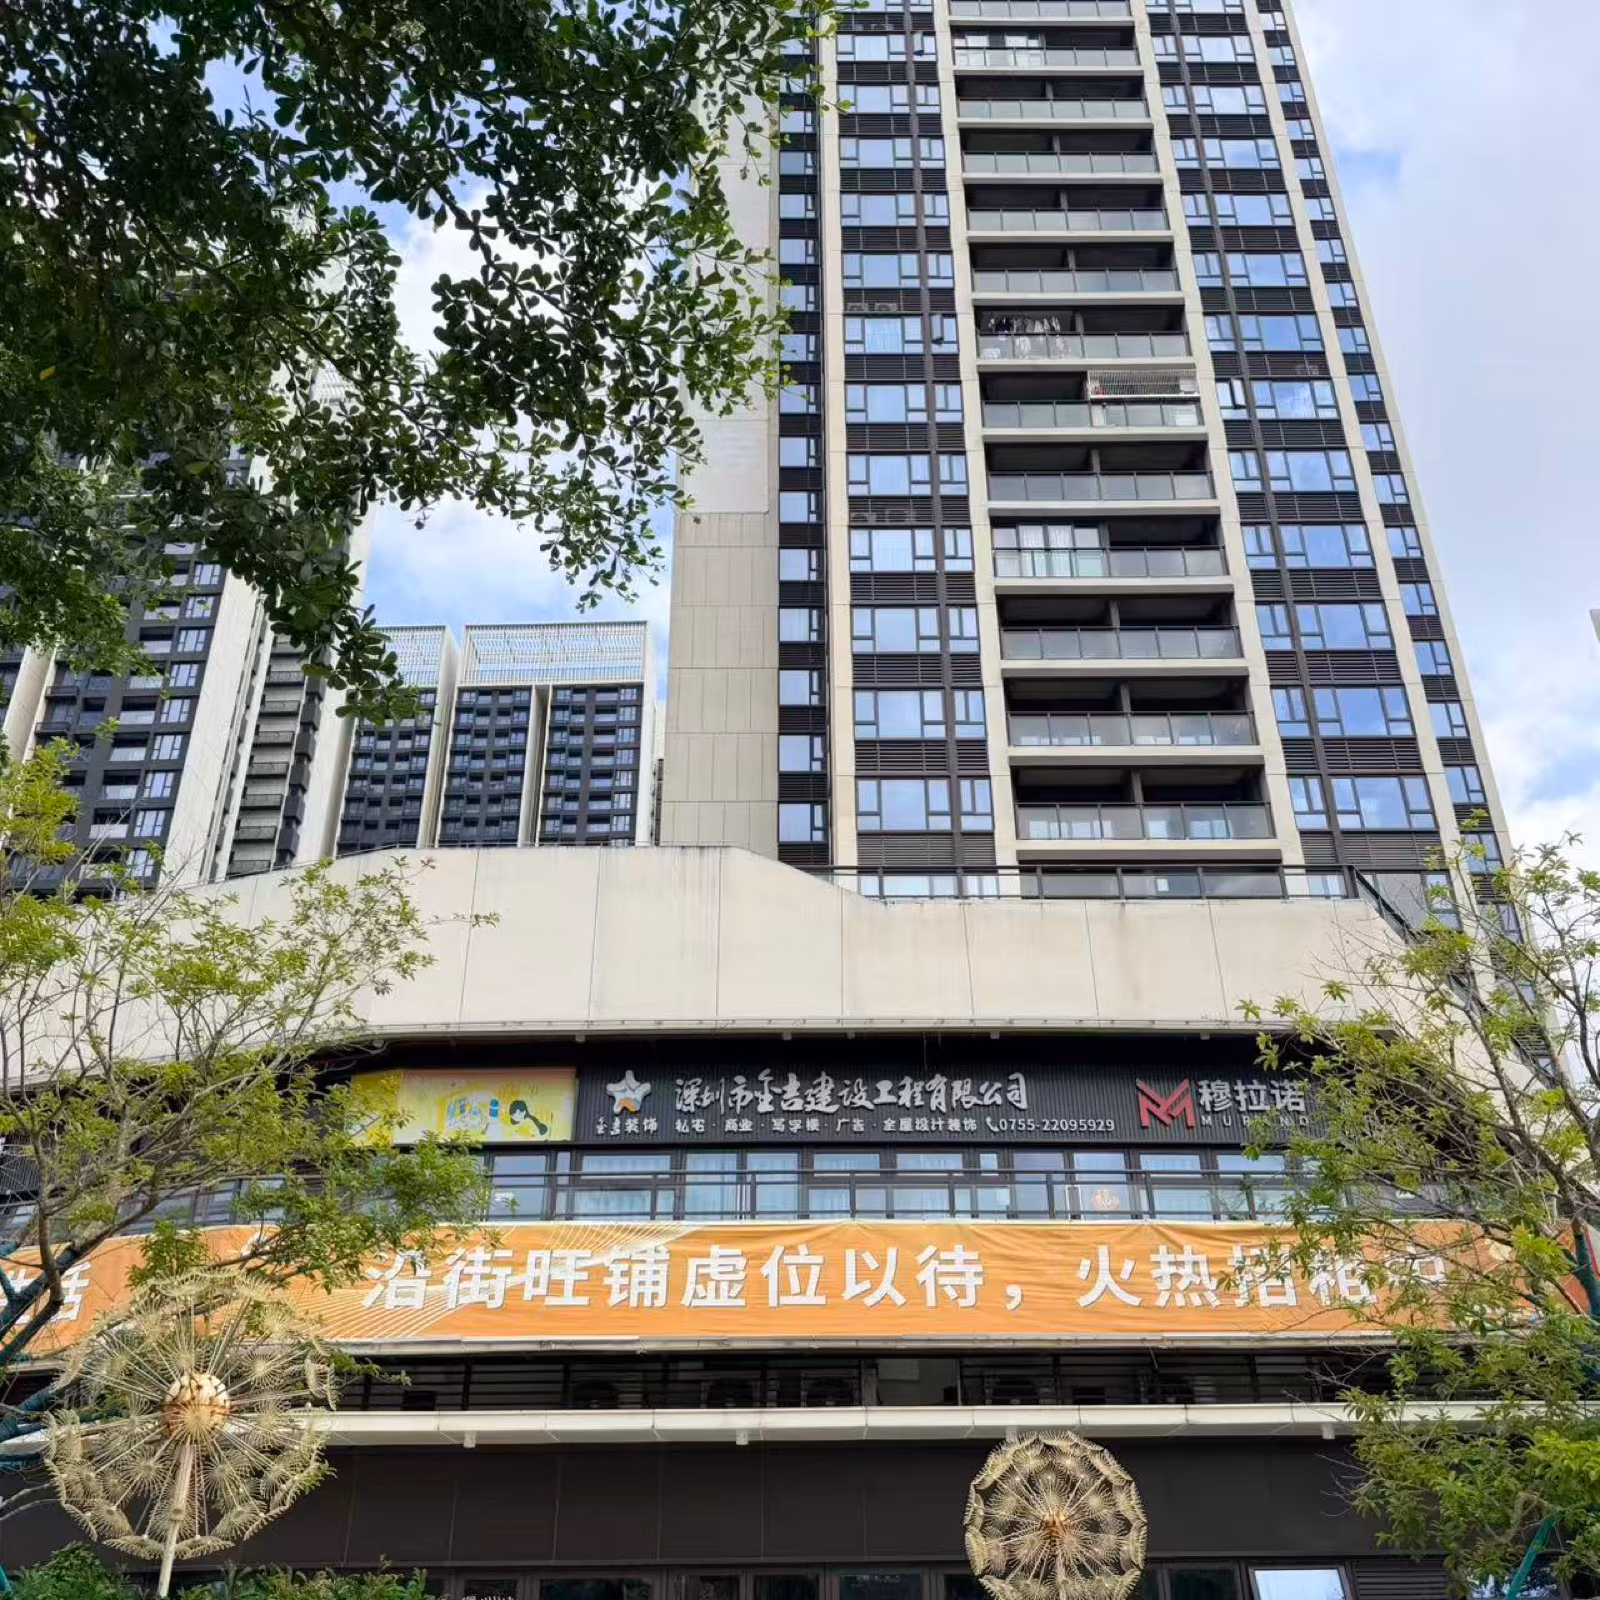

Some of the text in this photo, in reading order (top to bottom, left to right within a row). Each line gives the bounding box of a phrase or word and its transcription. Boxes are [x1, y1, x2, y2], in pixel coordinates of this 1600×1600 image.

[1199, 1079, 1306, 1112] 穆拉诺
[1000, 1118, 1115, 1131] 0755-22095929
